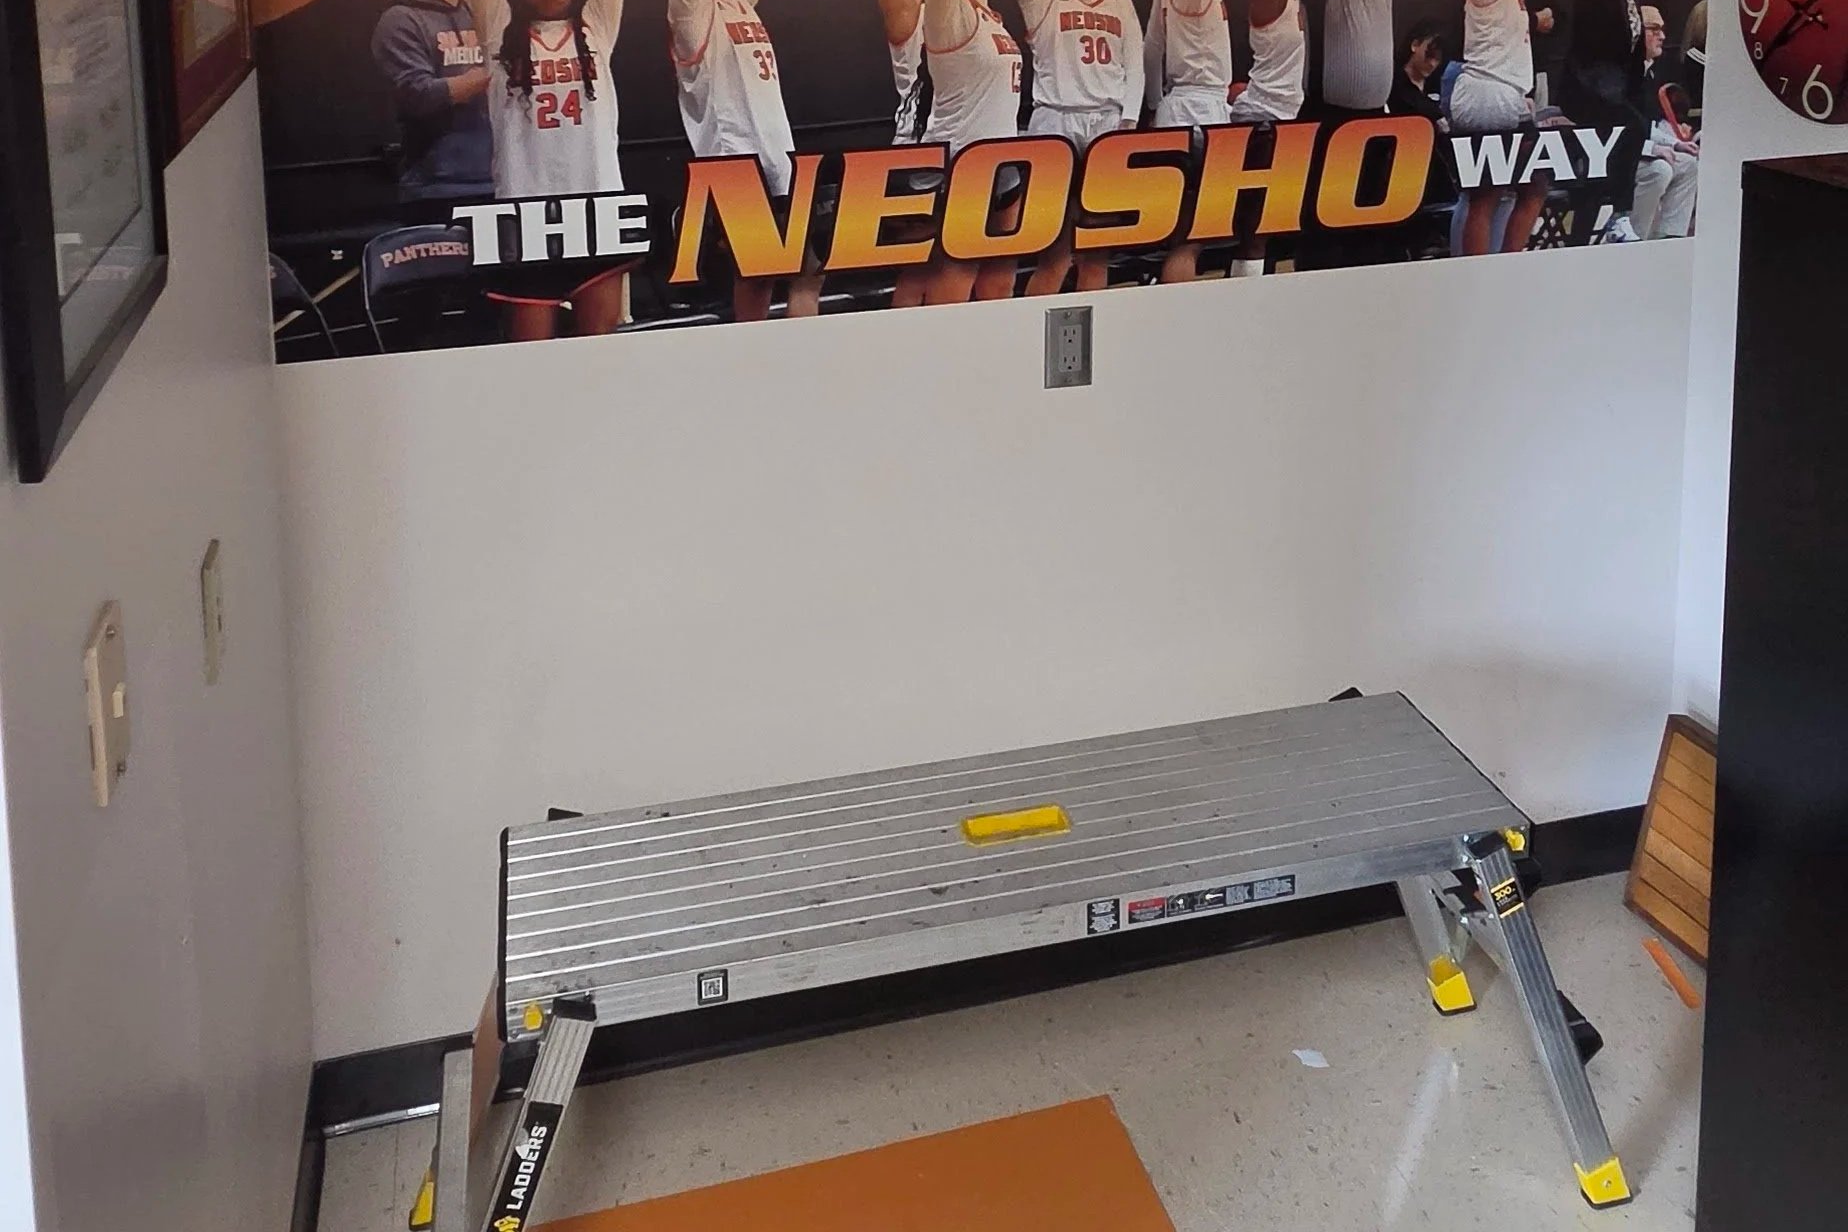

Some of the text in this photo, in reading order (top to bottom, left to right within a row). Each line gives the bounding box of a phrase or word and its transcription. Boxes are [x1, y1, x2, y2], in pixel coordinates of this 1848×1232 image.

[1079, 35, 1111, 65] 30
[1753, 41, 1764, 60] 8
[1779, 76, 1788, 95] 7
[1802, 64, 1834, 120] 6
[535, 89, 583, 129] 24
[452, 115, 1626, 284] THE NEOSHO WAY
[505, 1125, 548, 1210] LADDERS
